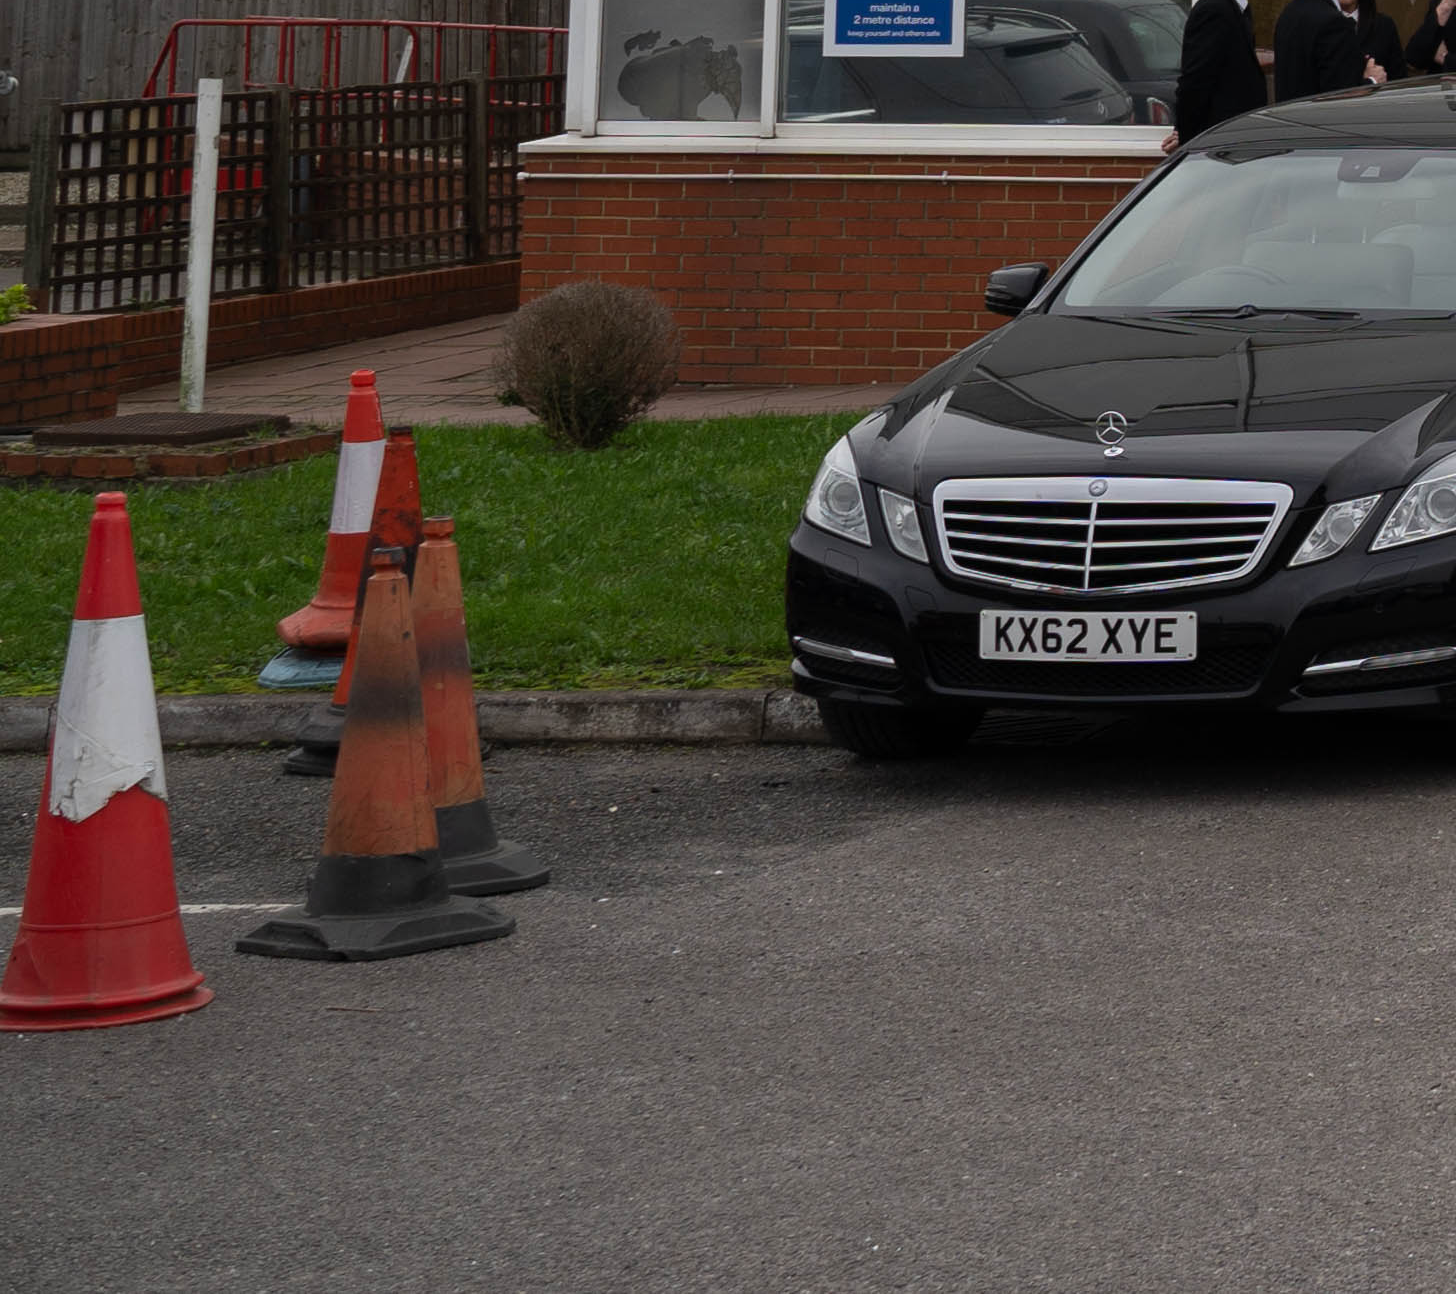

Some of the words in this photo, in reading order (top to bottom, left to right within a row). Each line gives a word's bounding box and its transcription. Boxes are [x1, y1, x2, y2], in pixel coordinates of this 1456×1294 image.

[869, 3, 912, 12] maintain
[913, 5, 920, 13] a
[853, 15, 861, 25] 2
[862, 15, 892, 25] metre
[893, 15, 935, 25] distance
[995, 616, 1089, 653] KX62
[1101, 618, 1178, 654] XYE
